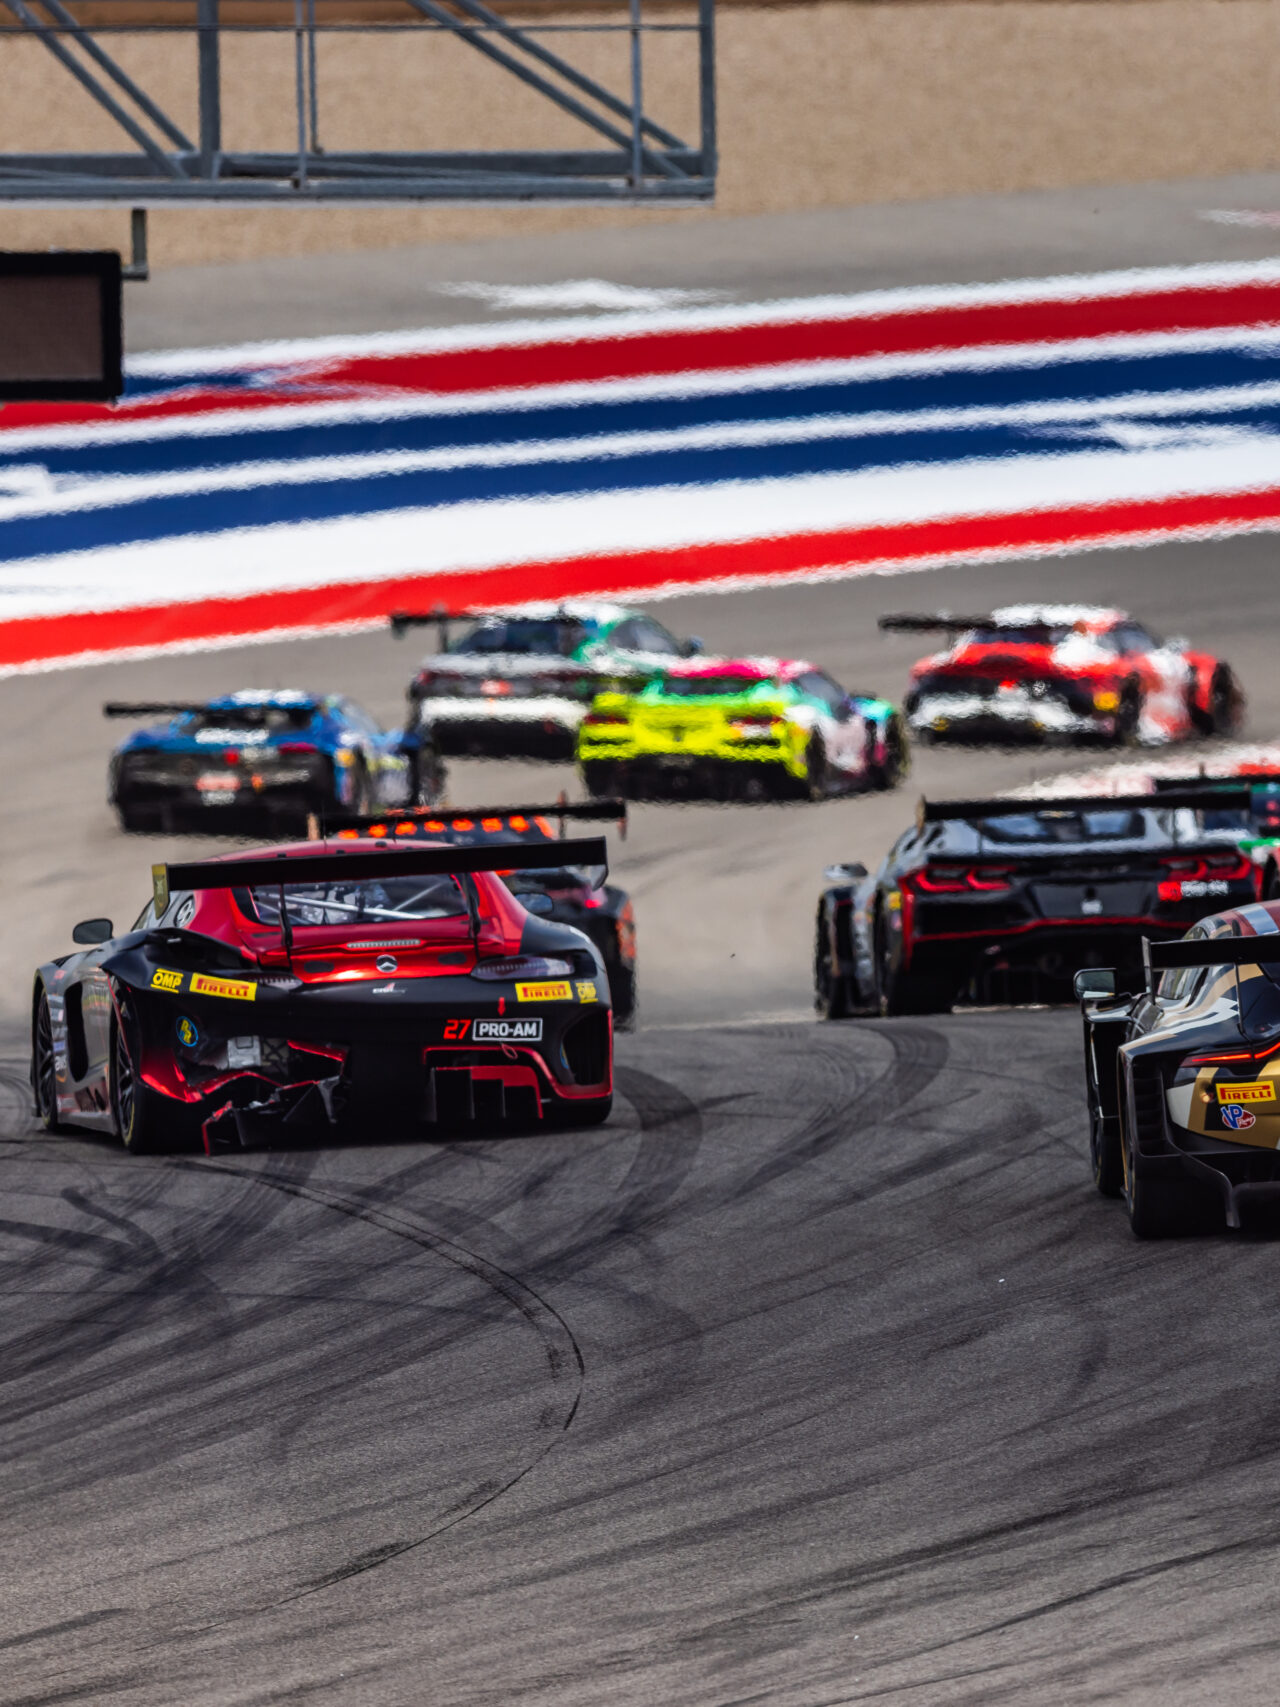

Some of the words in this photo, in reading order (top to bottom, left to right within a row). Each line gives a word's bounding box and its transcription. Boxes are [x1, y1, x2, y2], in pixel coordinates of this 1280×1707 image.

[152, 971, 182, 990] OMP
[196, 977, 250, 998] PIRELLI
[521, 984, 567, 999] PIRELLI
[443, 1019, 472, 1040] 27
[478, 1021, 537, 1037] PRO-AM
[1219, 1085, 1272, 1100] PIRELLI
[1220, 1104, 1243, 1129] VP
